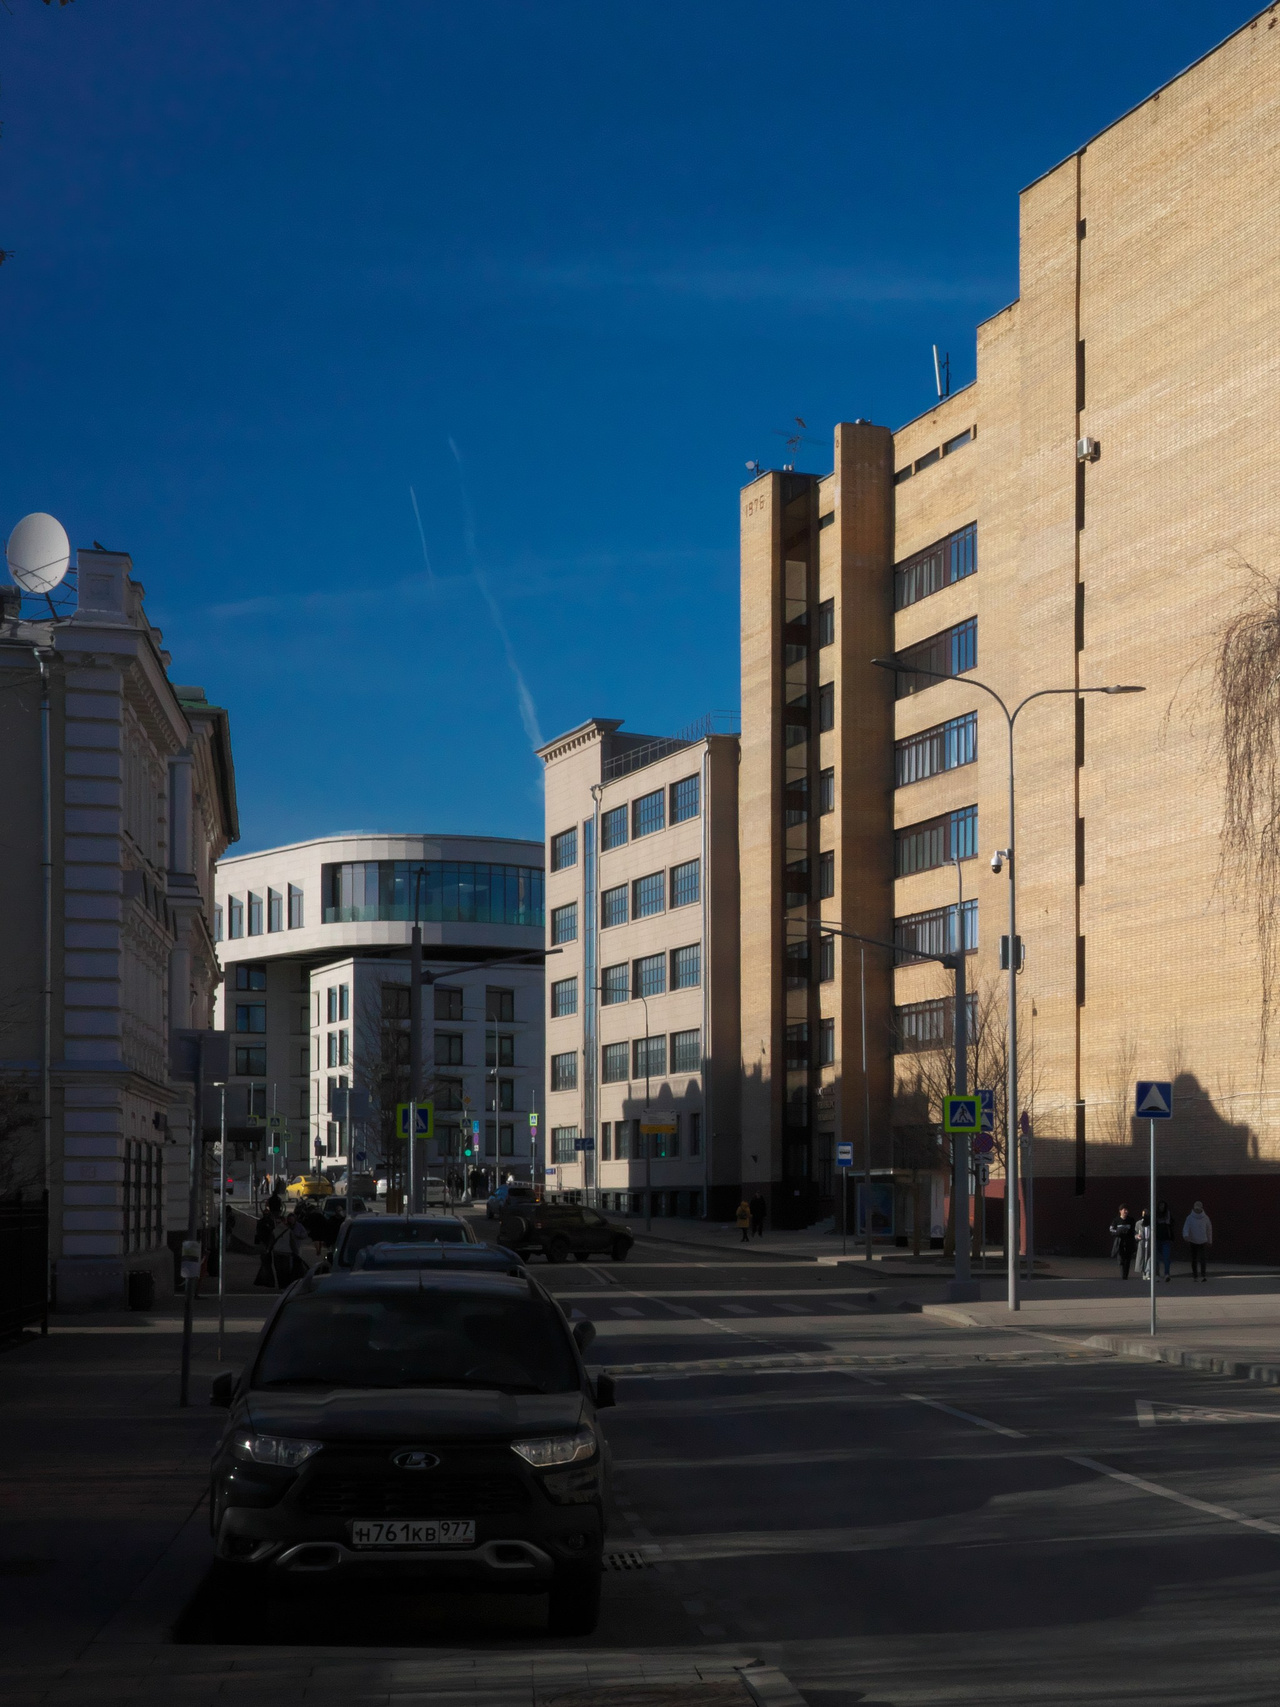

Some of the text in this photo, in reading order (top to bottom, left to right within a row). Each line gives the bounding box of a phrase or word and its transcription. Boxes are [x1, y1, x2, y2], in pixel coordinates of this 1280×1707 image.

[745, 495, 765, 518] 1976
[359, 1521, 470, 1542] Н761КВ 977
